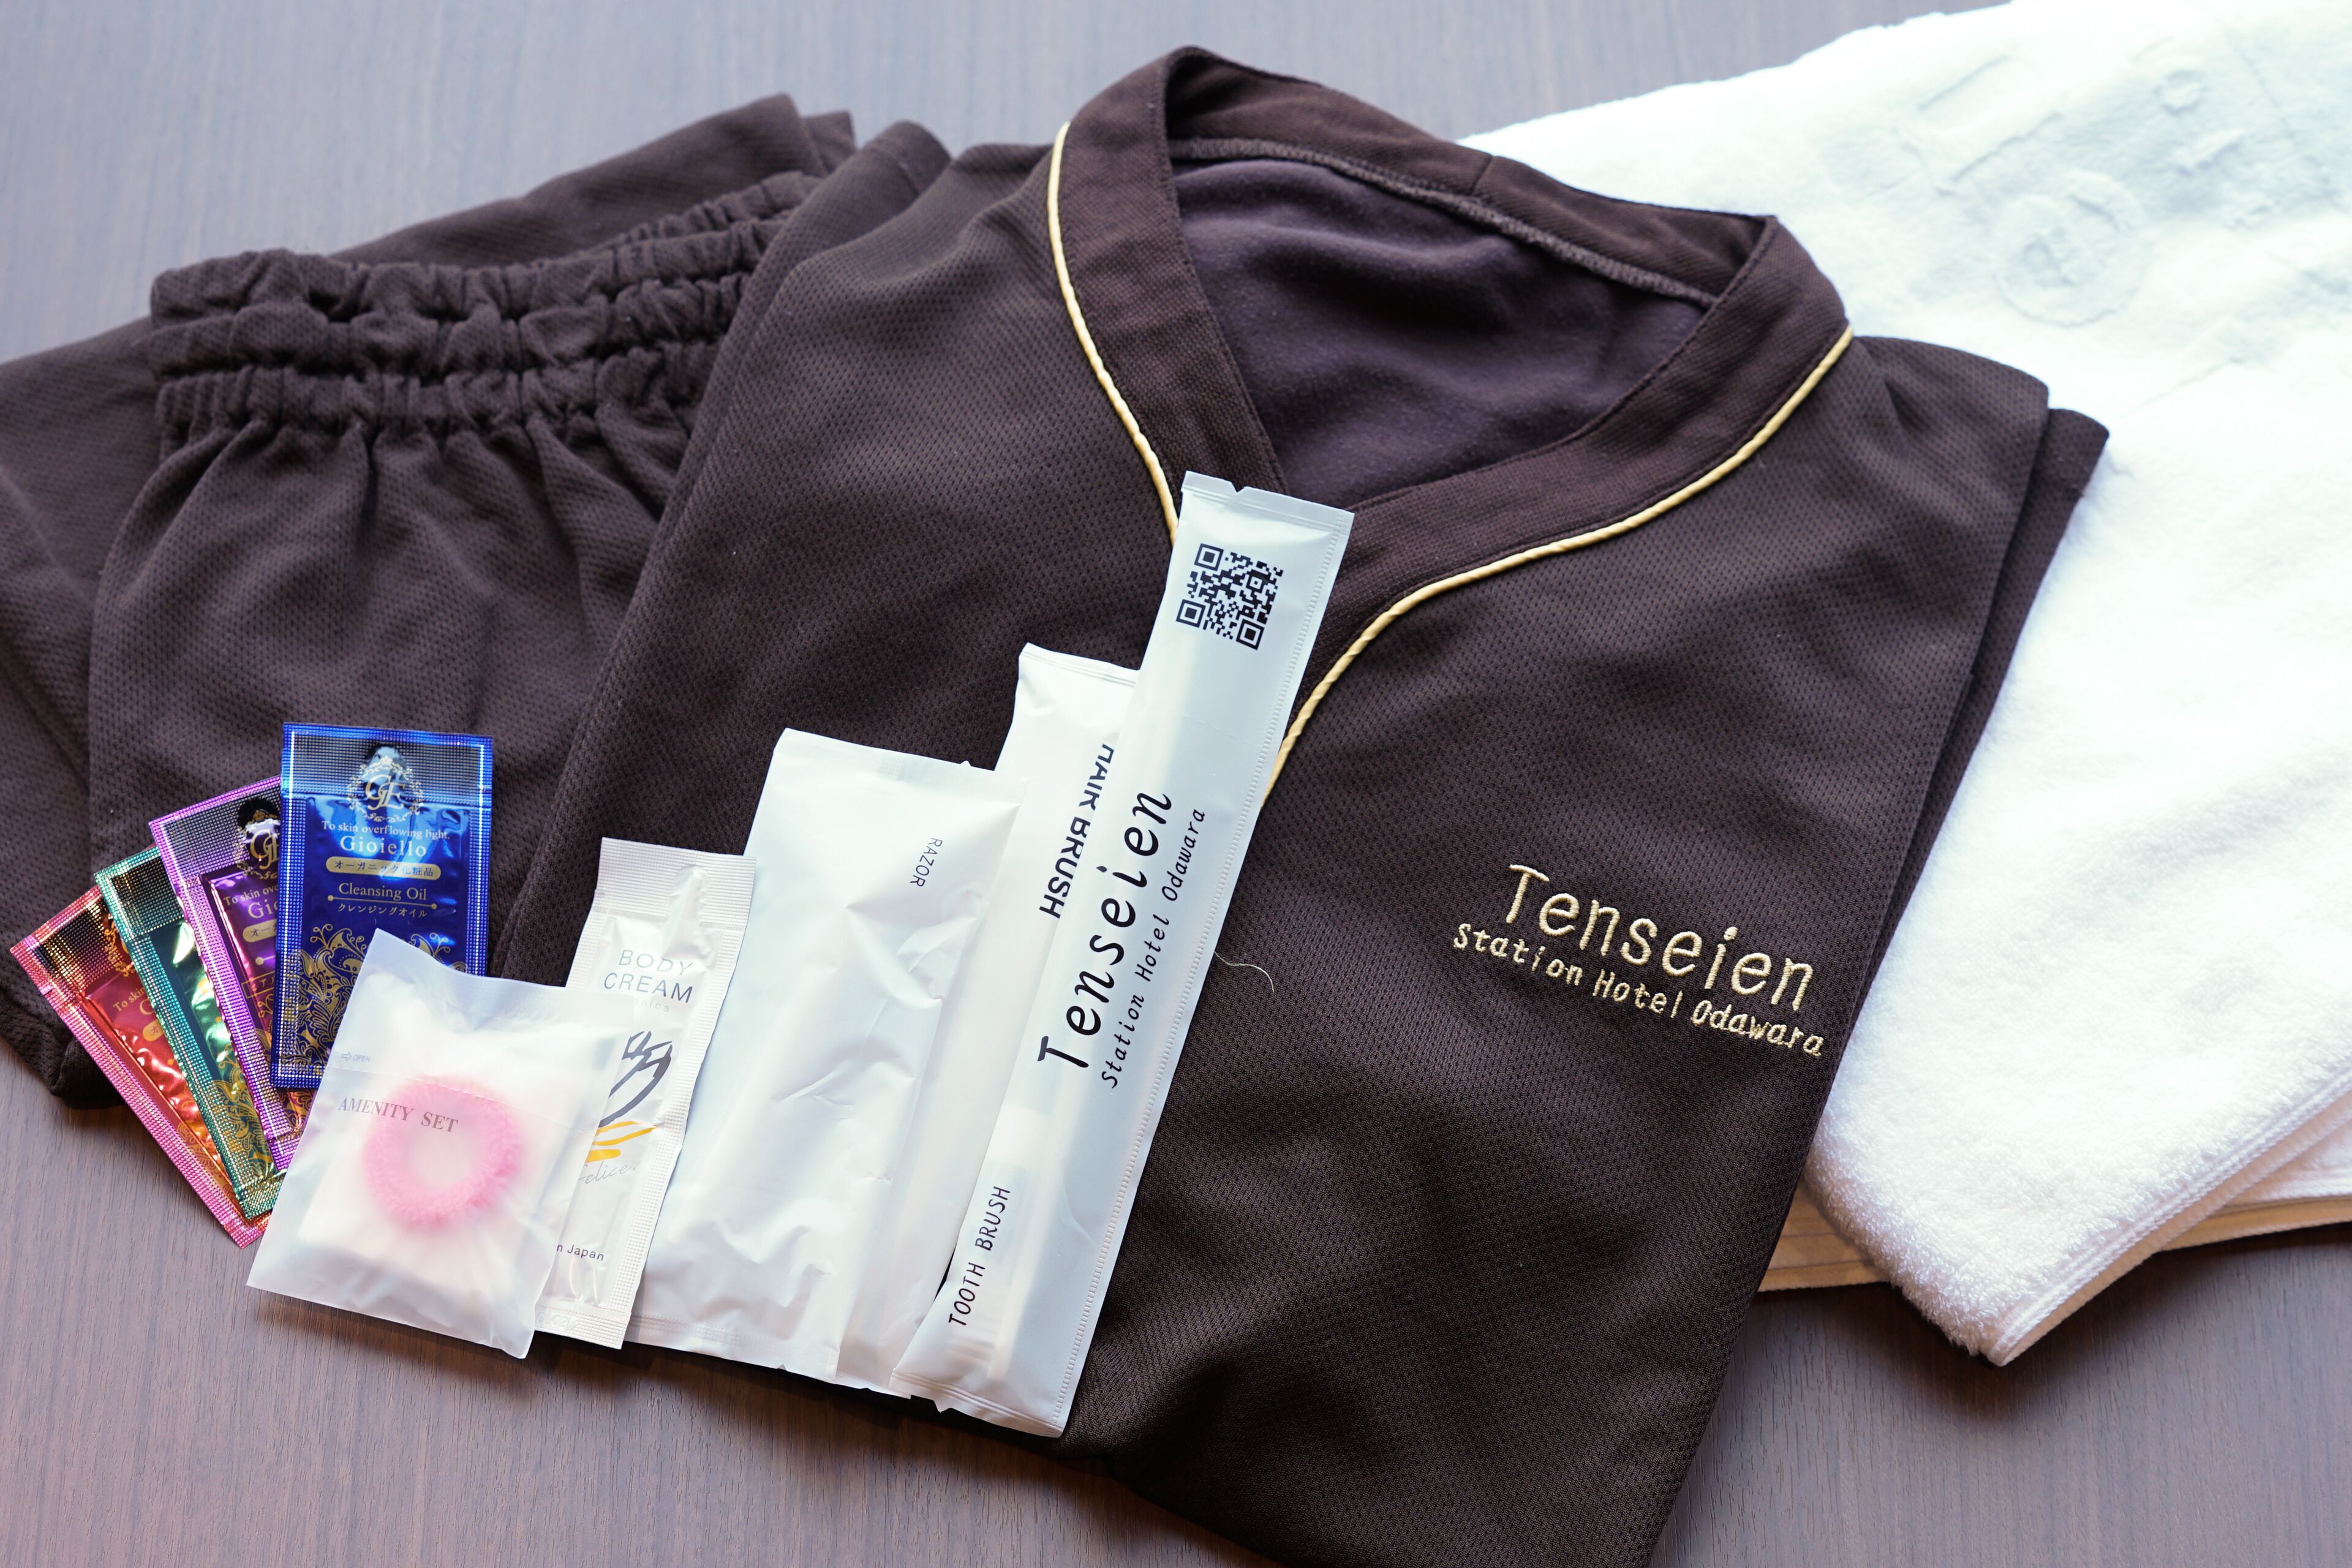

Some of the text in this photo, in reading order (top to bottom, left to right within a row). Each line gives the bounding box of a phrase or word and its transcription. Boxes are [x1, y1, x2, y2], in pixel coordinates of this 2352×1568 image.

[322, 820, 450, 840] To skin overflowing light.
[340, 835, 427, 857] Gioiello
[334, 861, 434, 877] オーガニック化粧品
[909, 837, 943, 888] RAZOR
[1039, 816, 1091, 919] BRUSH
[224, 896, 238, 907] To
[240, 889, 260, 902] skin
[338, 883, 427, 900] Cleansing Oil
[337, 903, 428, 918] クレンジングオイル
[1037, 792, 1172, 1068] Tenseien
[1506, 864, 1814, 1012] Tenseien
[618, 949, 693, 976] BODY
[1101, 809, 1205, 1089] Station Hotel Odawara
[603, 972, 693, 1004] CREAM
[1453, 922, 1825, 1057] Station Hotel Odawara
[113, 1001, 128, 1012] To
[352, 1054, 371, 1063] OPEN
[337, 1097, 459, 1133] AMENITY SET
[567, 1244, 605, 1262] Japan
[948, 1186, 1011, 1326] TOOTH BRUSH
